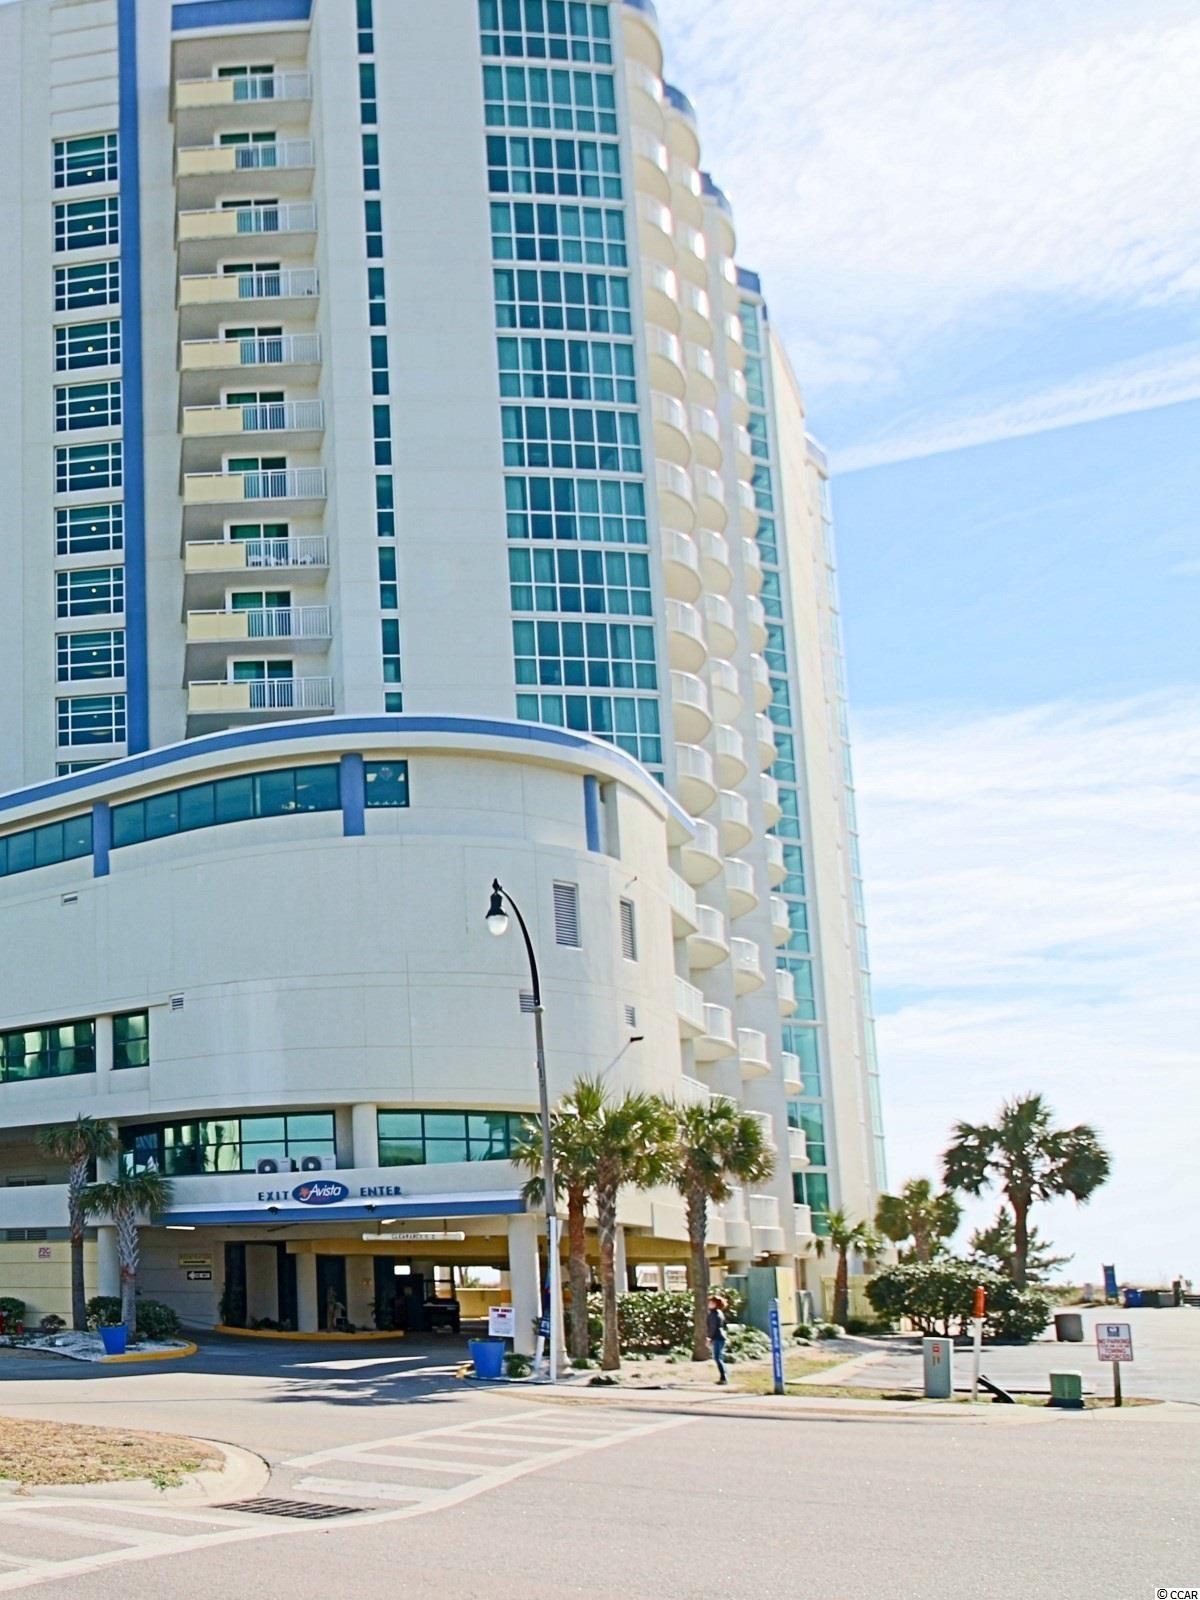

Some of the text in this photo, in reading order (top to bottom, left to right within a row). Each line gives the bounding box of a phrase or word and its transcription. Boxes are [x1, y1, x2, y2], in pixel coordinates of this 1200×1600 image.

[258, 1191, 288, 1201] EXIT
[300, 1184, 341, 1201] Avista
[360, 1185, 402, 1197] ENTER
